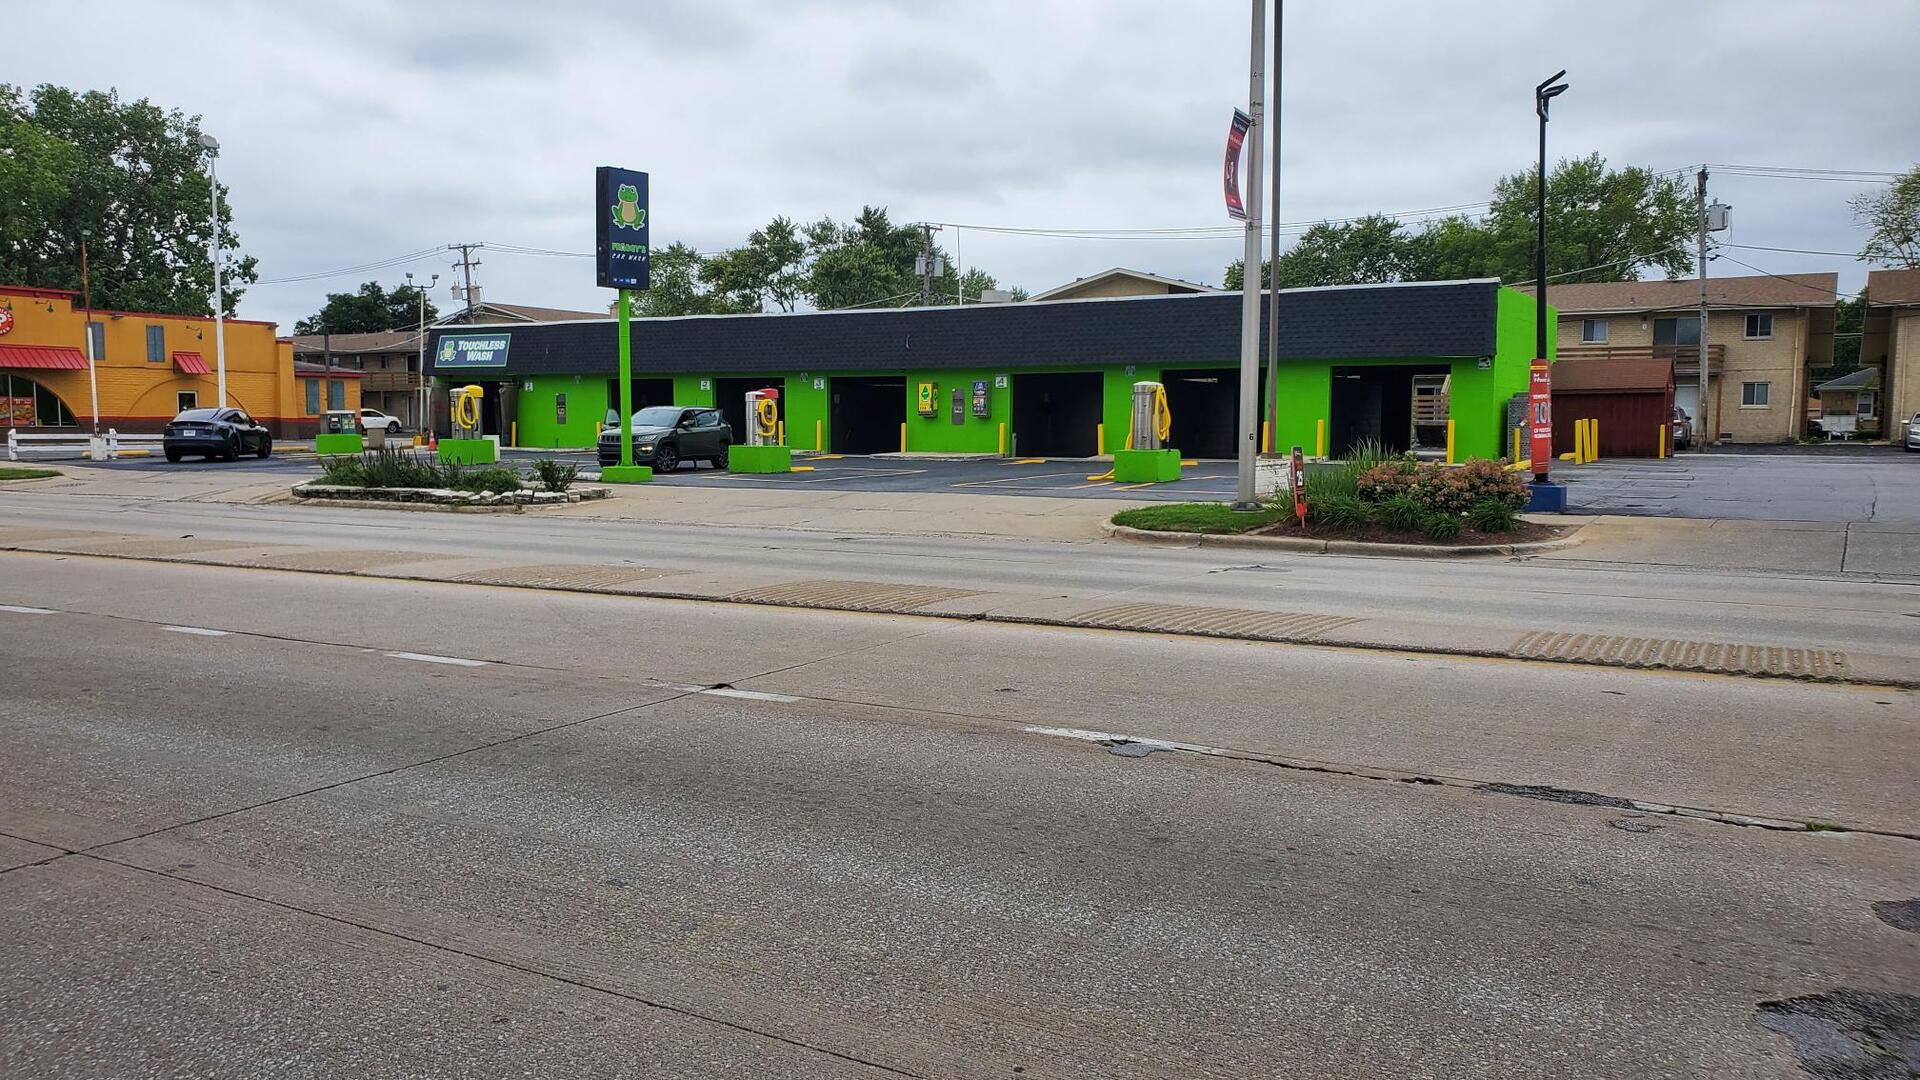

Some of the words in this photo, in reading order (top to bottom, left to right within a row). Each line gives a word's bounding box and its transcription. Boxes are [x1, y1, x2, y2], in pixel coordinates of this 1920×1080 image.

[458, 340, 506, 351] TOUCHLESS
[466, 350, 494, 361] WASH
[1249, 433, 1254, 441] 6
